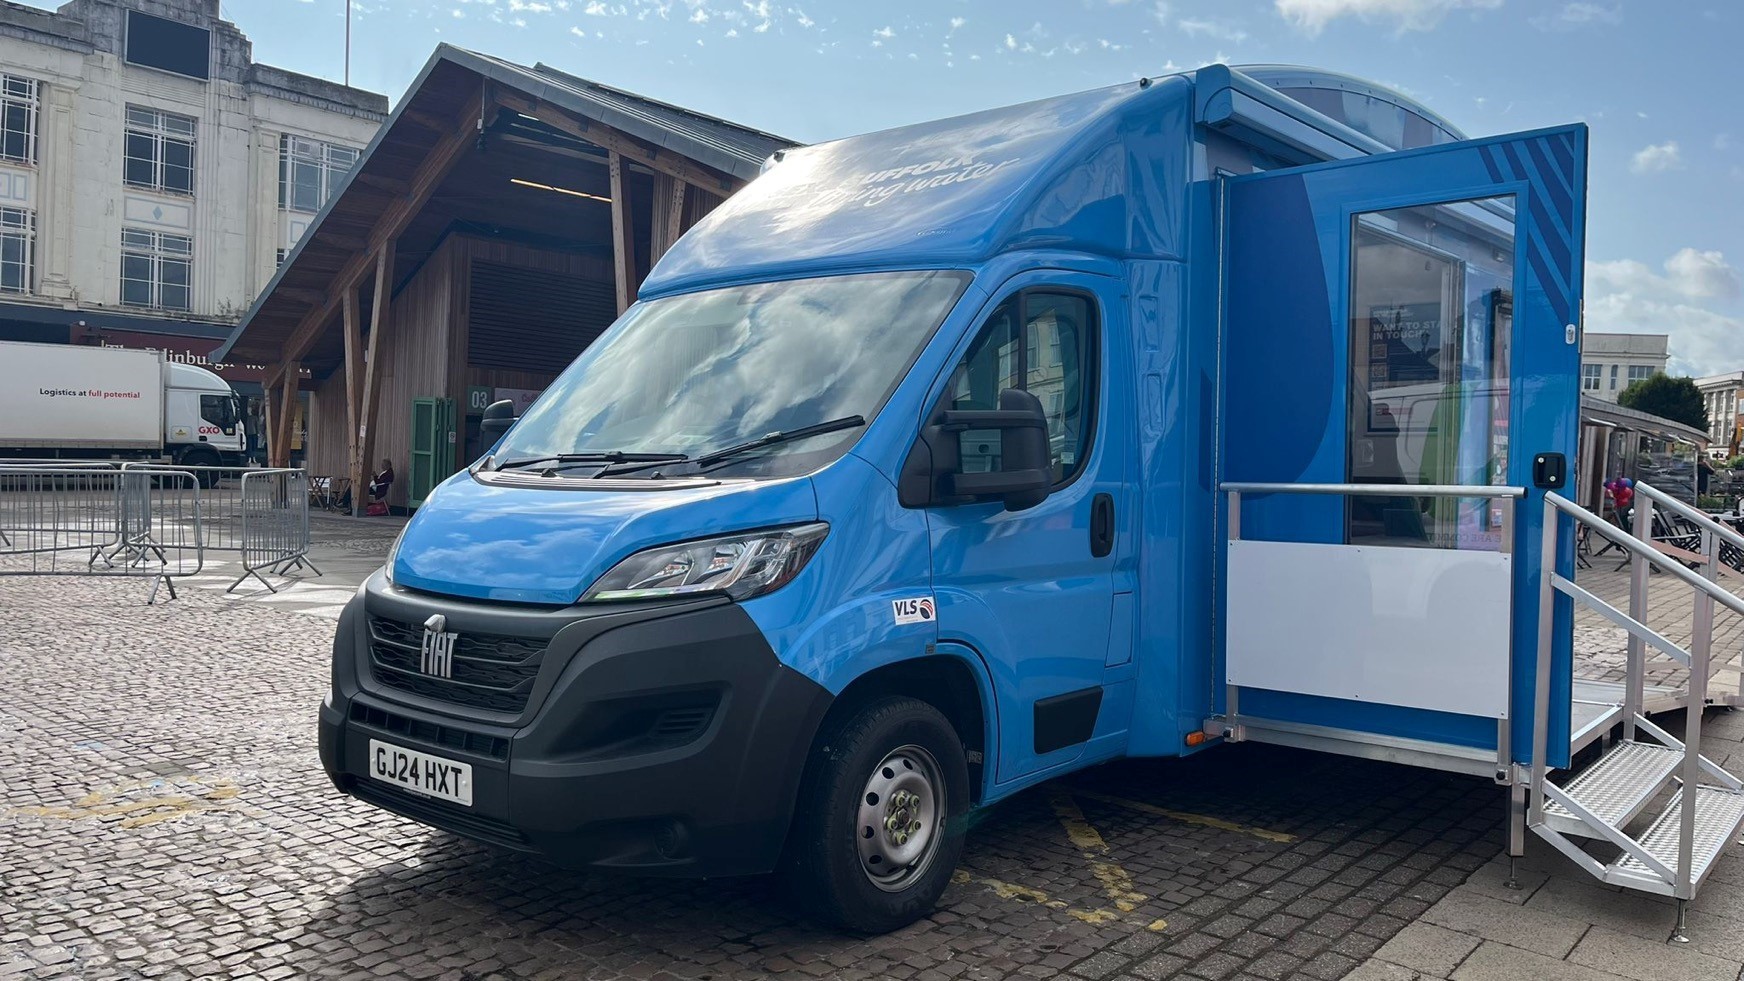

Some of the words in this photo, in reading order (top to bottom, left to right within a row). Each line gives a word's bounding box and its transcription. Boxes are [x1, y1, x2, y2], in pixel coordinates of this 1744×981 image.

[840, 149, 978, 190] UFFOLK
[904, 157, 1021, 195] water
[1373, 322, 1403, 332] WANT
[1405, 321, 1420, 330] TO
[1373, 331, 1383, 340] IN
[39, 387, 76, 397] Logistics
[78, 389, 87, 397] at
[88, 389, 102, 397] full
[103, 391, 141, 399] potential
[471, 390, 488, 409] 03
[198, 426, 220, 434] GXO
[894, 600, 917, 616] VLS
[421, 628, 459, 679] FIAT
[376, 747, 420, 787] GJ24
[425, 759, 462, 797] HXT
